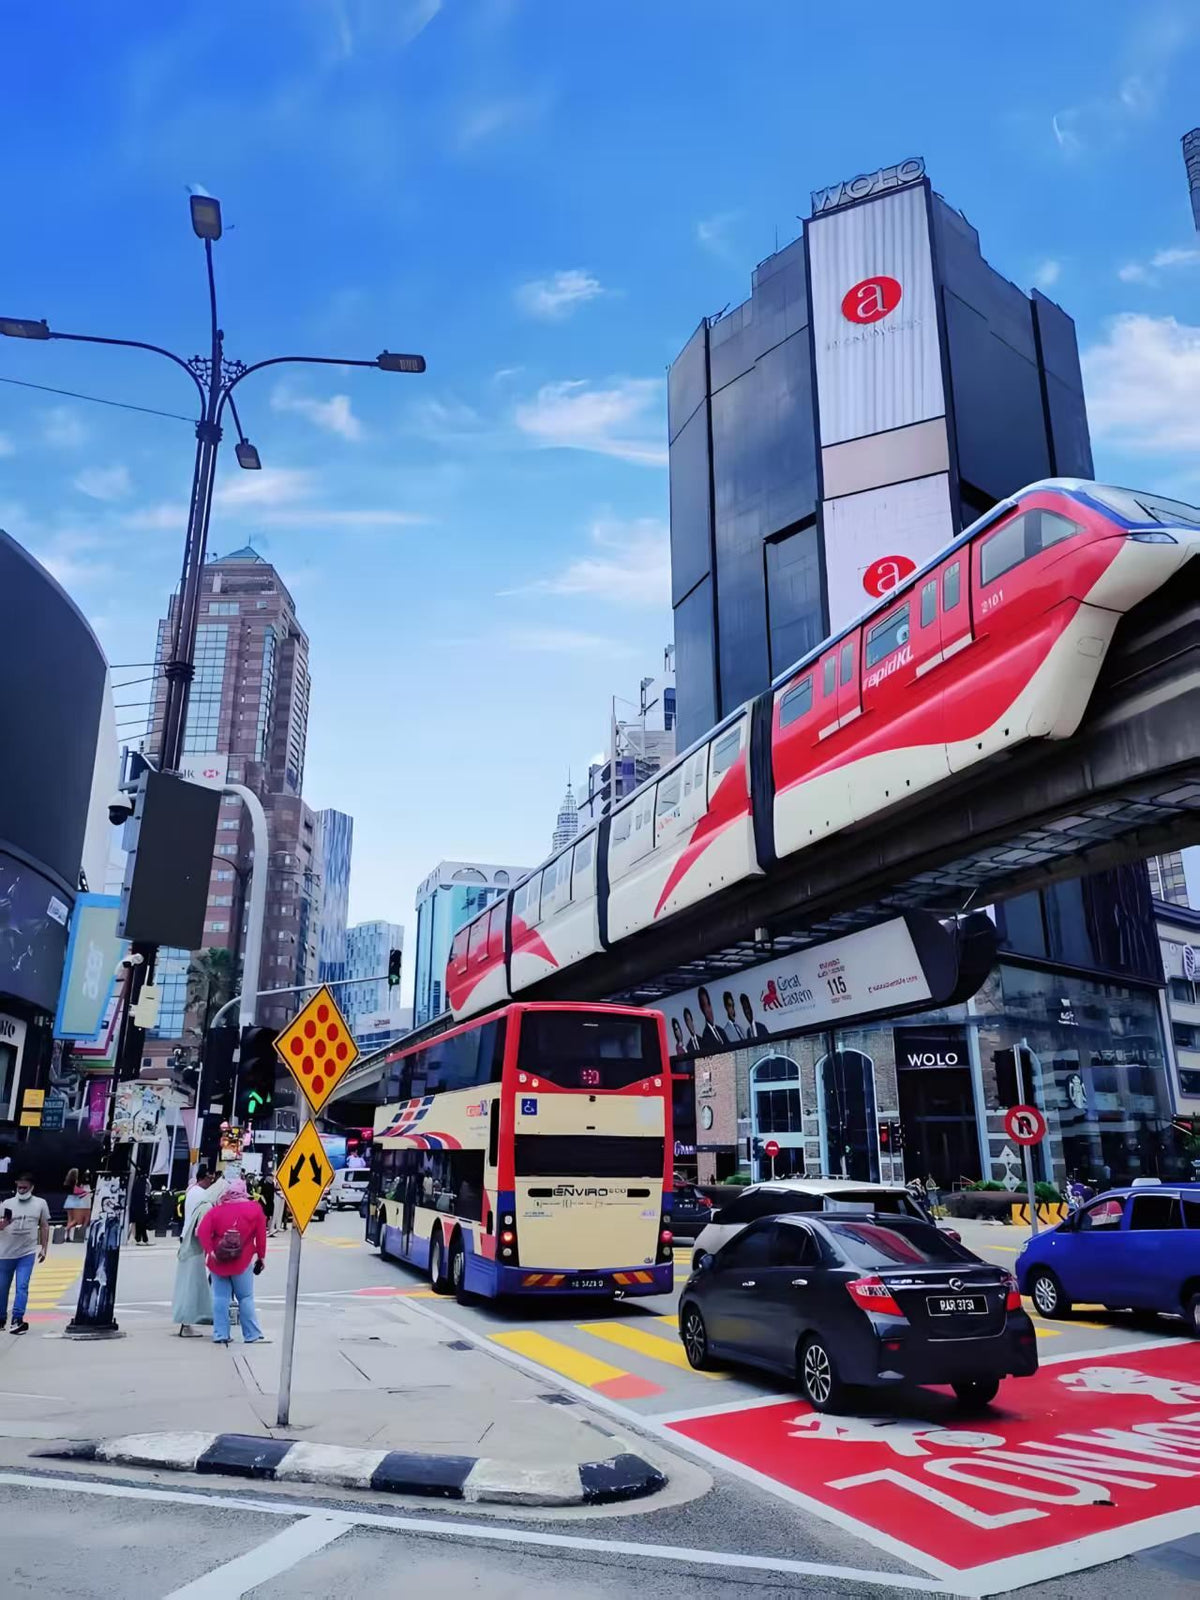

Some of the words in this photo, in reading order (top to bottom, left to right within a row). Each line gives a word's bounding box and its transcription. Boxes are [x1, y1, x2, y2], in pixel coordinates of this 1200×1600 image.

[811, 157, 925, 214] WOLO
[862, 645, 914, 690] rapidKL
[777, 974, 802, 991] Great
[827, 975, 847, 996] 115
[780, 989, 814, 1007] Eastern
[907, 1052, 958, 1067] WOLO
[553, 1187, 608, 1197] ENVIRO
